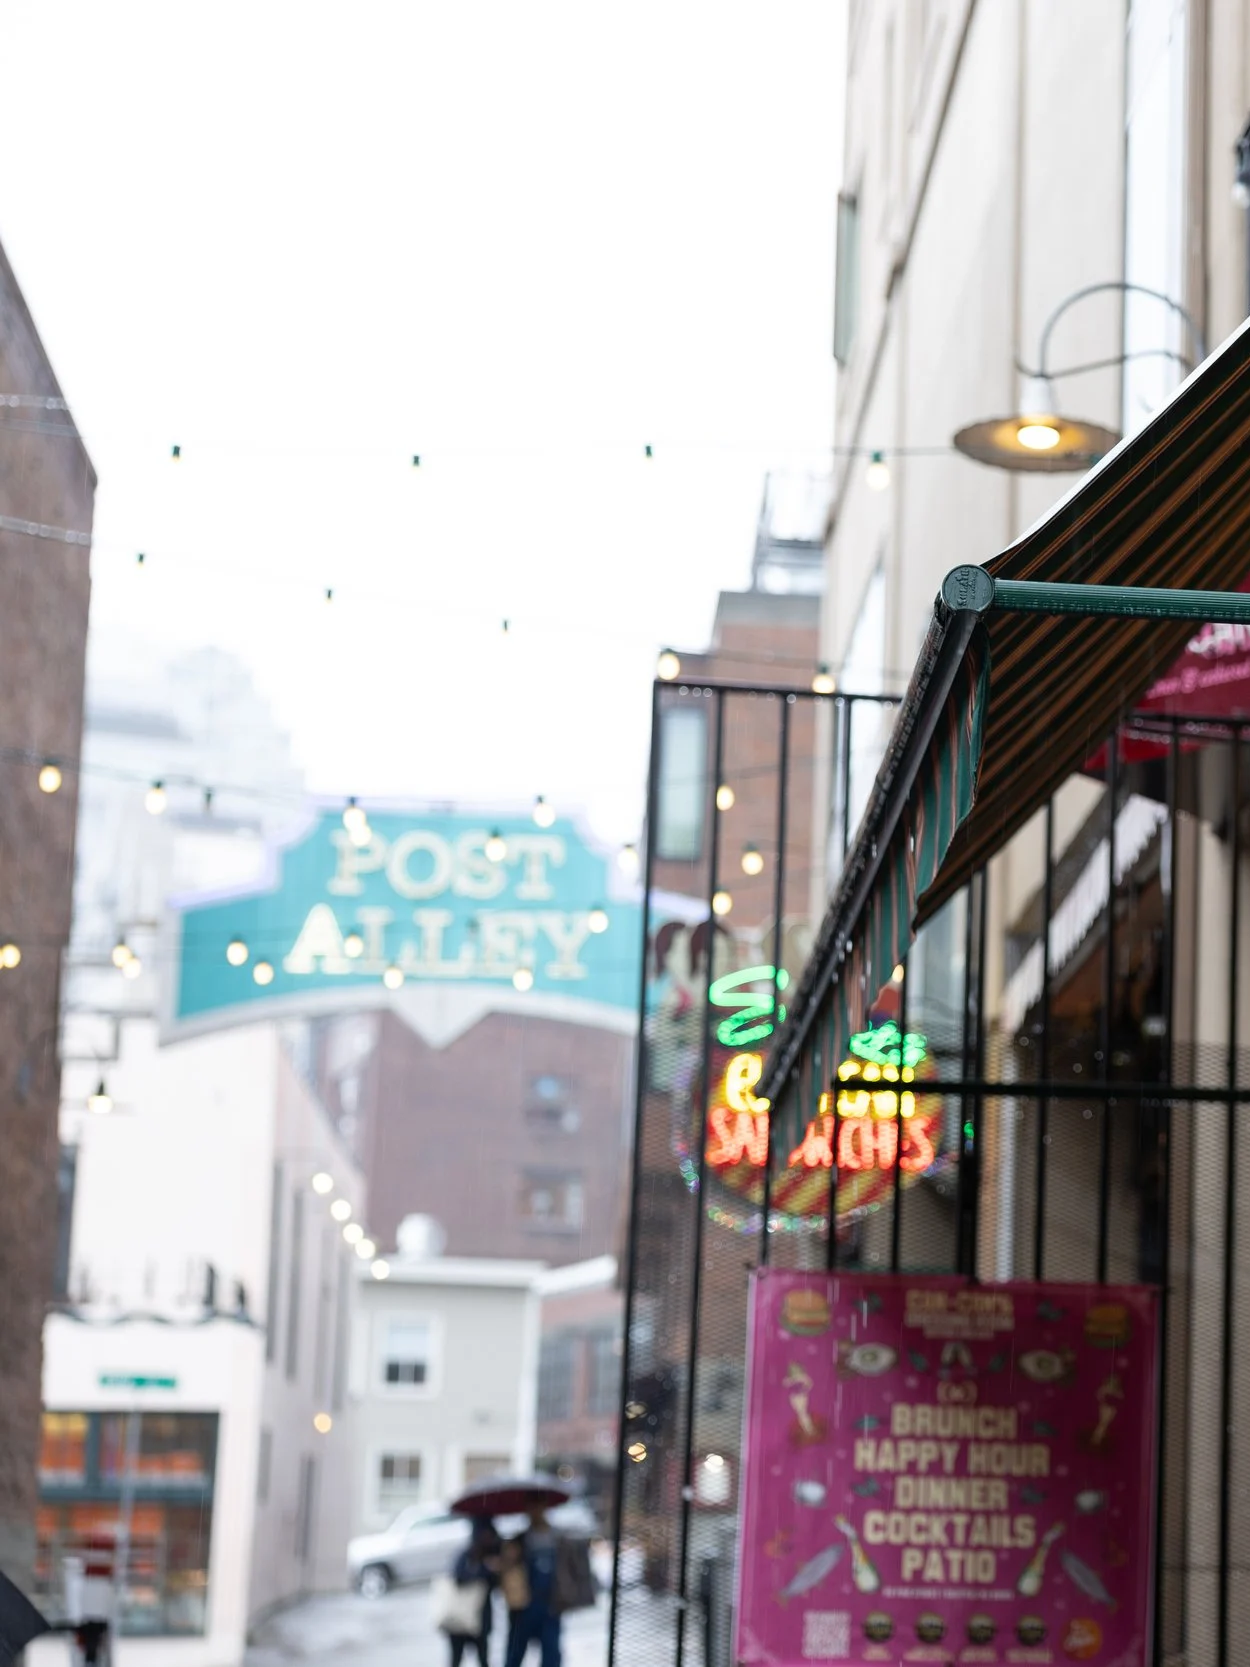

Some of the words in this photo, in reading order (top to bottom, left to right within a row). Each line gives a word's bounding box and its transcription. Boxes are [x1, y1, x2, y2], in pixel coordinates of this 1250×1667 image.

[327, 829, 565, 900] POST
[283, 903, 594, 979] ALLEY
[891, 1403, 1017, 1439] BRUNCH
[854, 1438, 959, 1473] HAPPY
[968, 1441, 1049, 1477] HOUR
[895, 1477, 1008, 1511] DINNER
[863, 1510, 1035, 1548] COCKTAILS
[901, 1549, 996, 1584] PATIO
